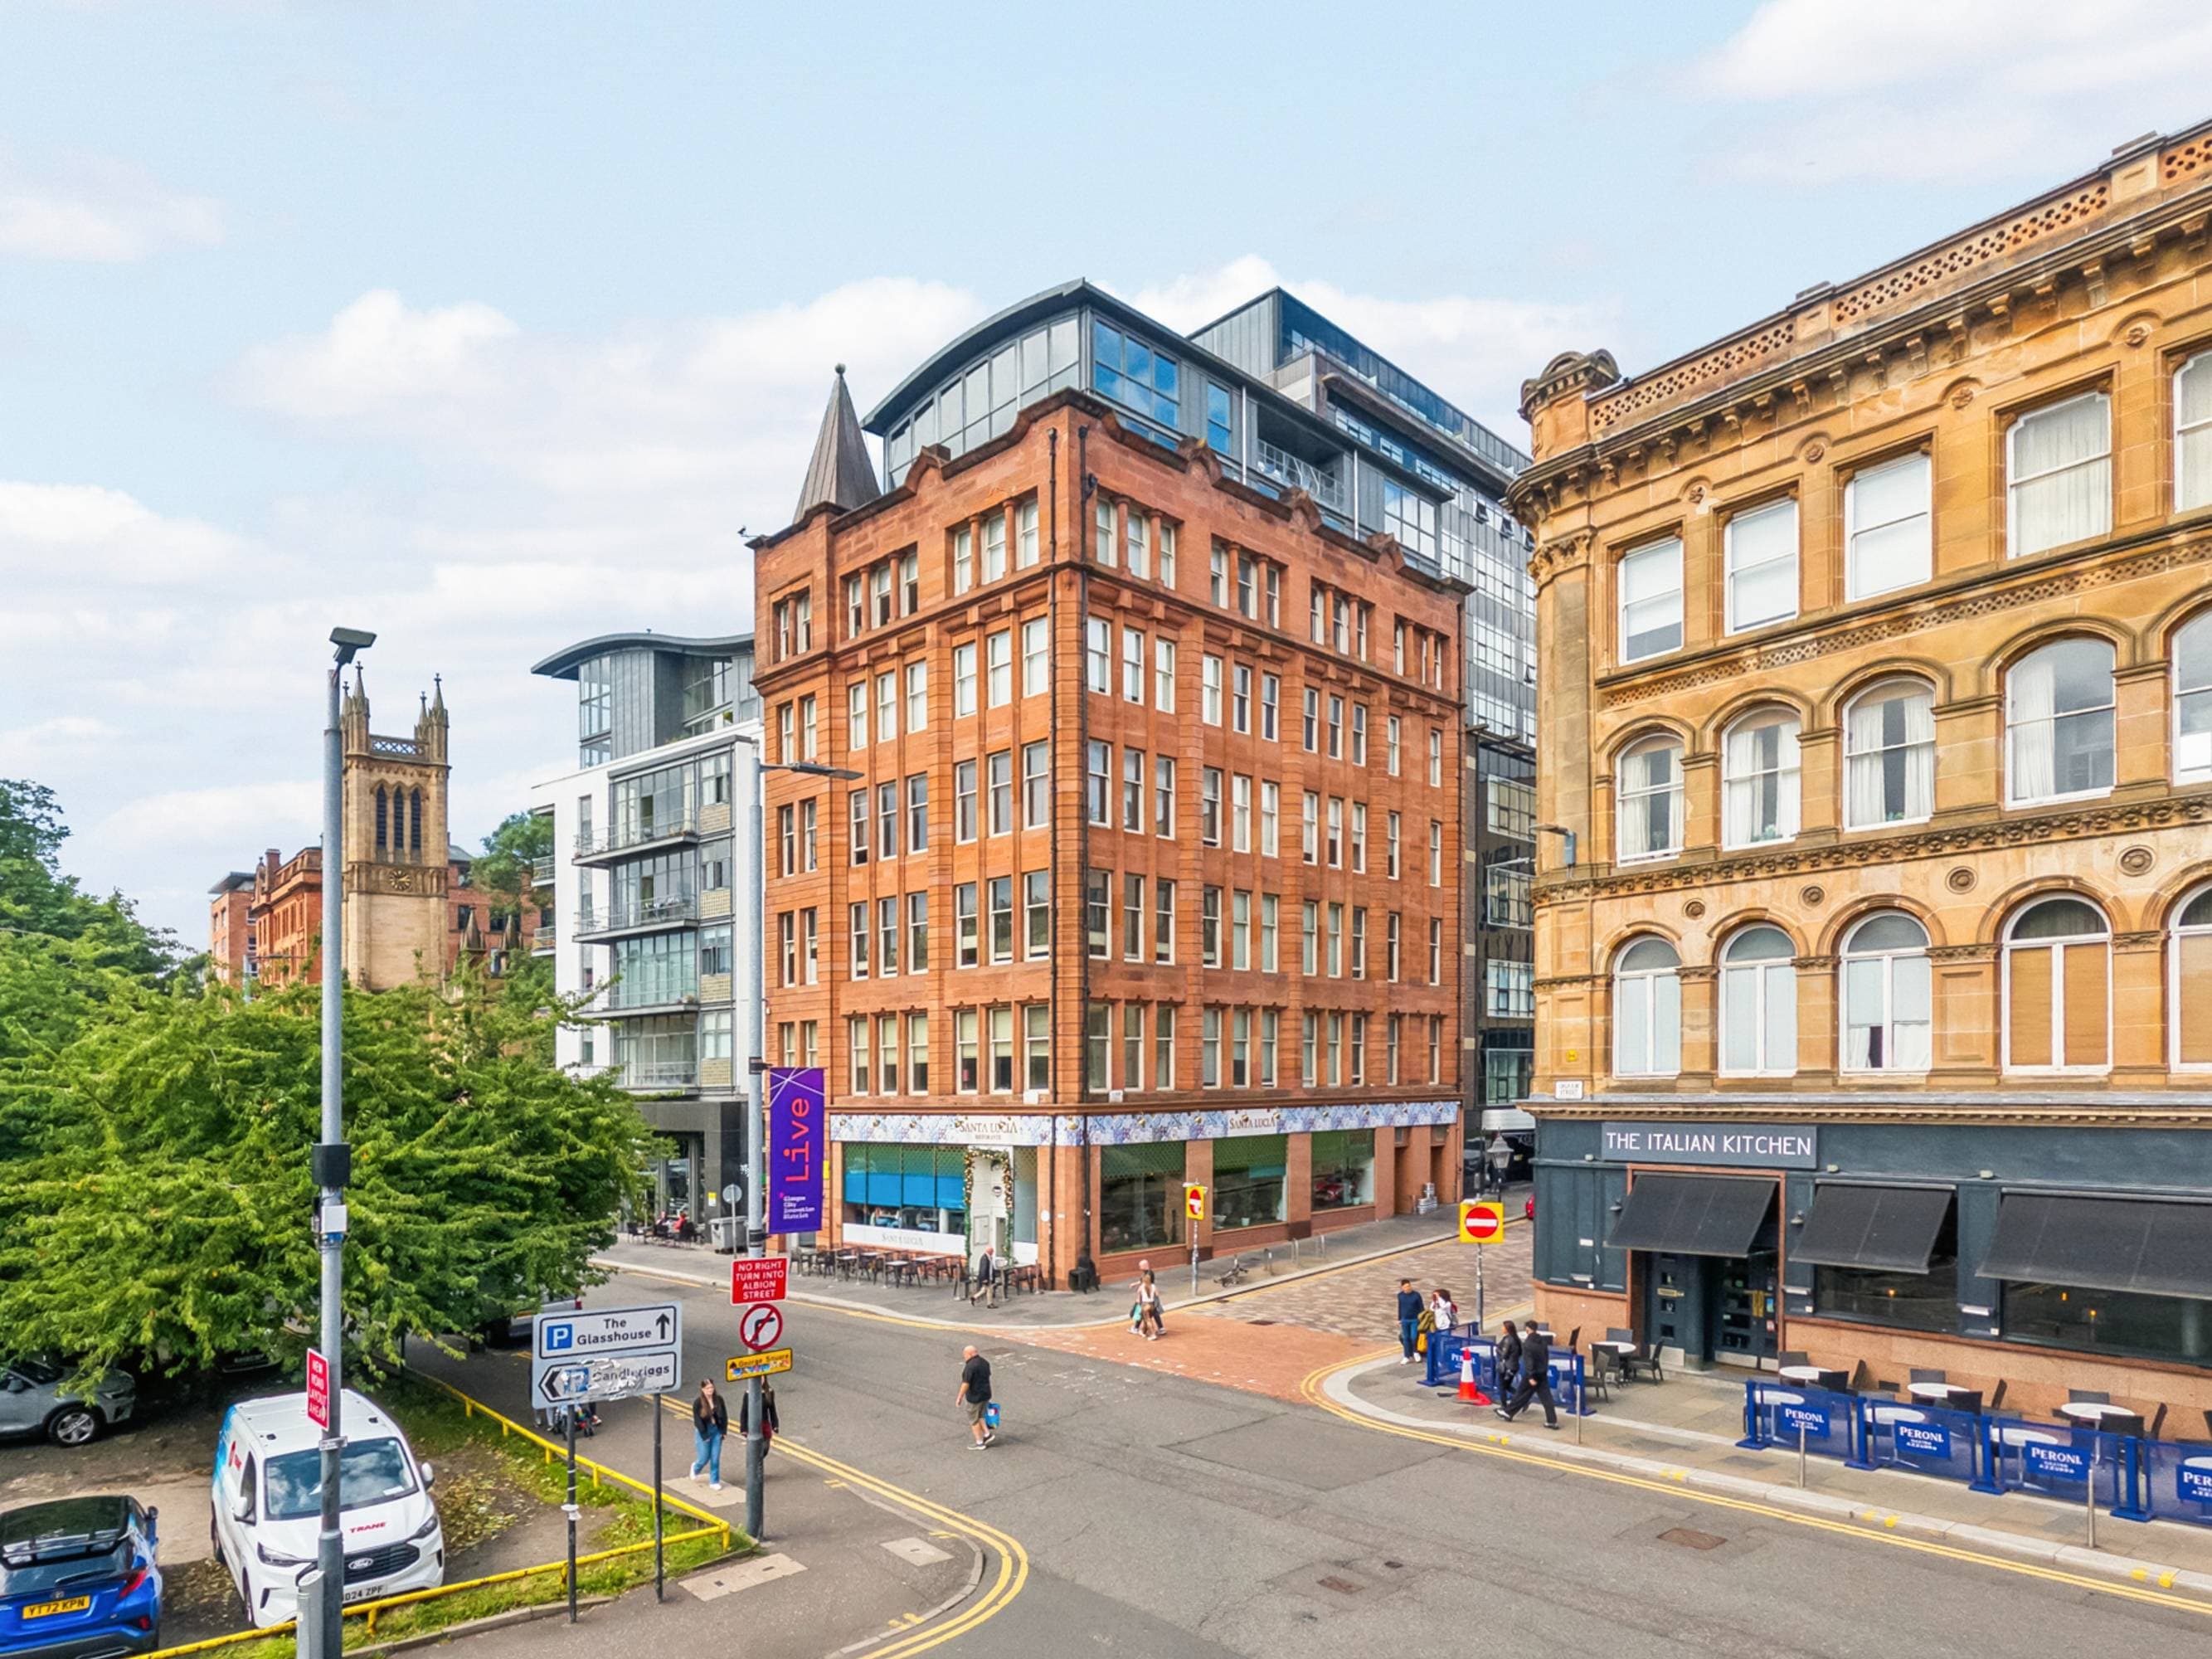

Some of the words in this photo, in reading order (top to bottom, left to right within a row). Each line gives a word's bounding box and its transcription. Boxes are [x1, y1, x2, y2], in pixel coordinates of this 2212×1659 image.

[960, 1121, 989, 1133] SANTA
[783, 1097, 810, 1182] Live
[1607, 1132, 1641, 1150] THE
[1647, 1133, 1715, 1153] ITALIAN
[1723, 1135, 1811, 1155] KITCHEN
[737, 1263, 752, 1272] NO
[755, 1261, 782, 1271] RIGHT
[736, 1272, 761, 1282] TURN
[763, 1270, 784, 1279] INTO
[742, 1280, 776, 1291] ALBION
[742, 1289, 775, 1300] STREET
[603, 1319, 627, 1329] The
[576, 1329, 652, 1345] Glasshouse
[309, 1402, 326, 1421] AHEA
[1785, 1408, 1825, 1423] PERONI
[1899, 1426, 1944, 1443] PERONI
[2031, 1447, 2083, 1465] PERONI
[349, 1521, 386, 1534] TRANE
[343, 1588, 362, 1602] D24
[365, 1585, 384, 1596] ZPF
[61, 1598, 85, 1611] KPN
